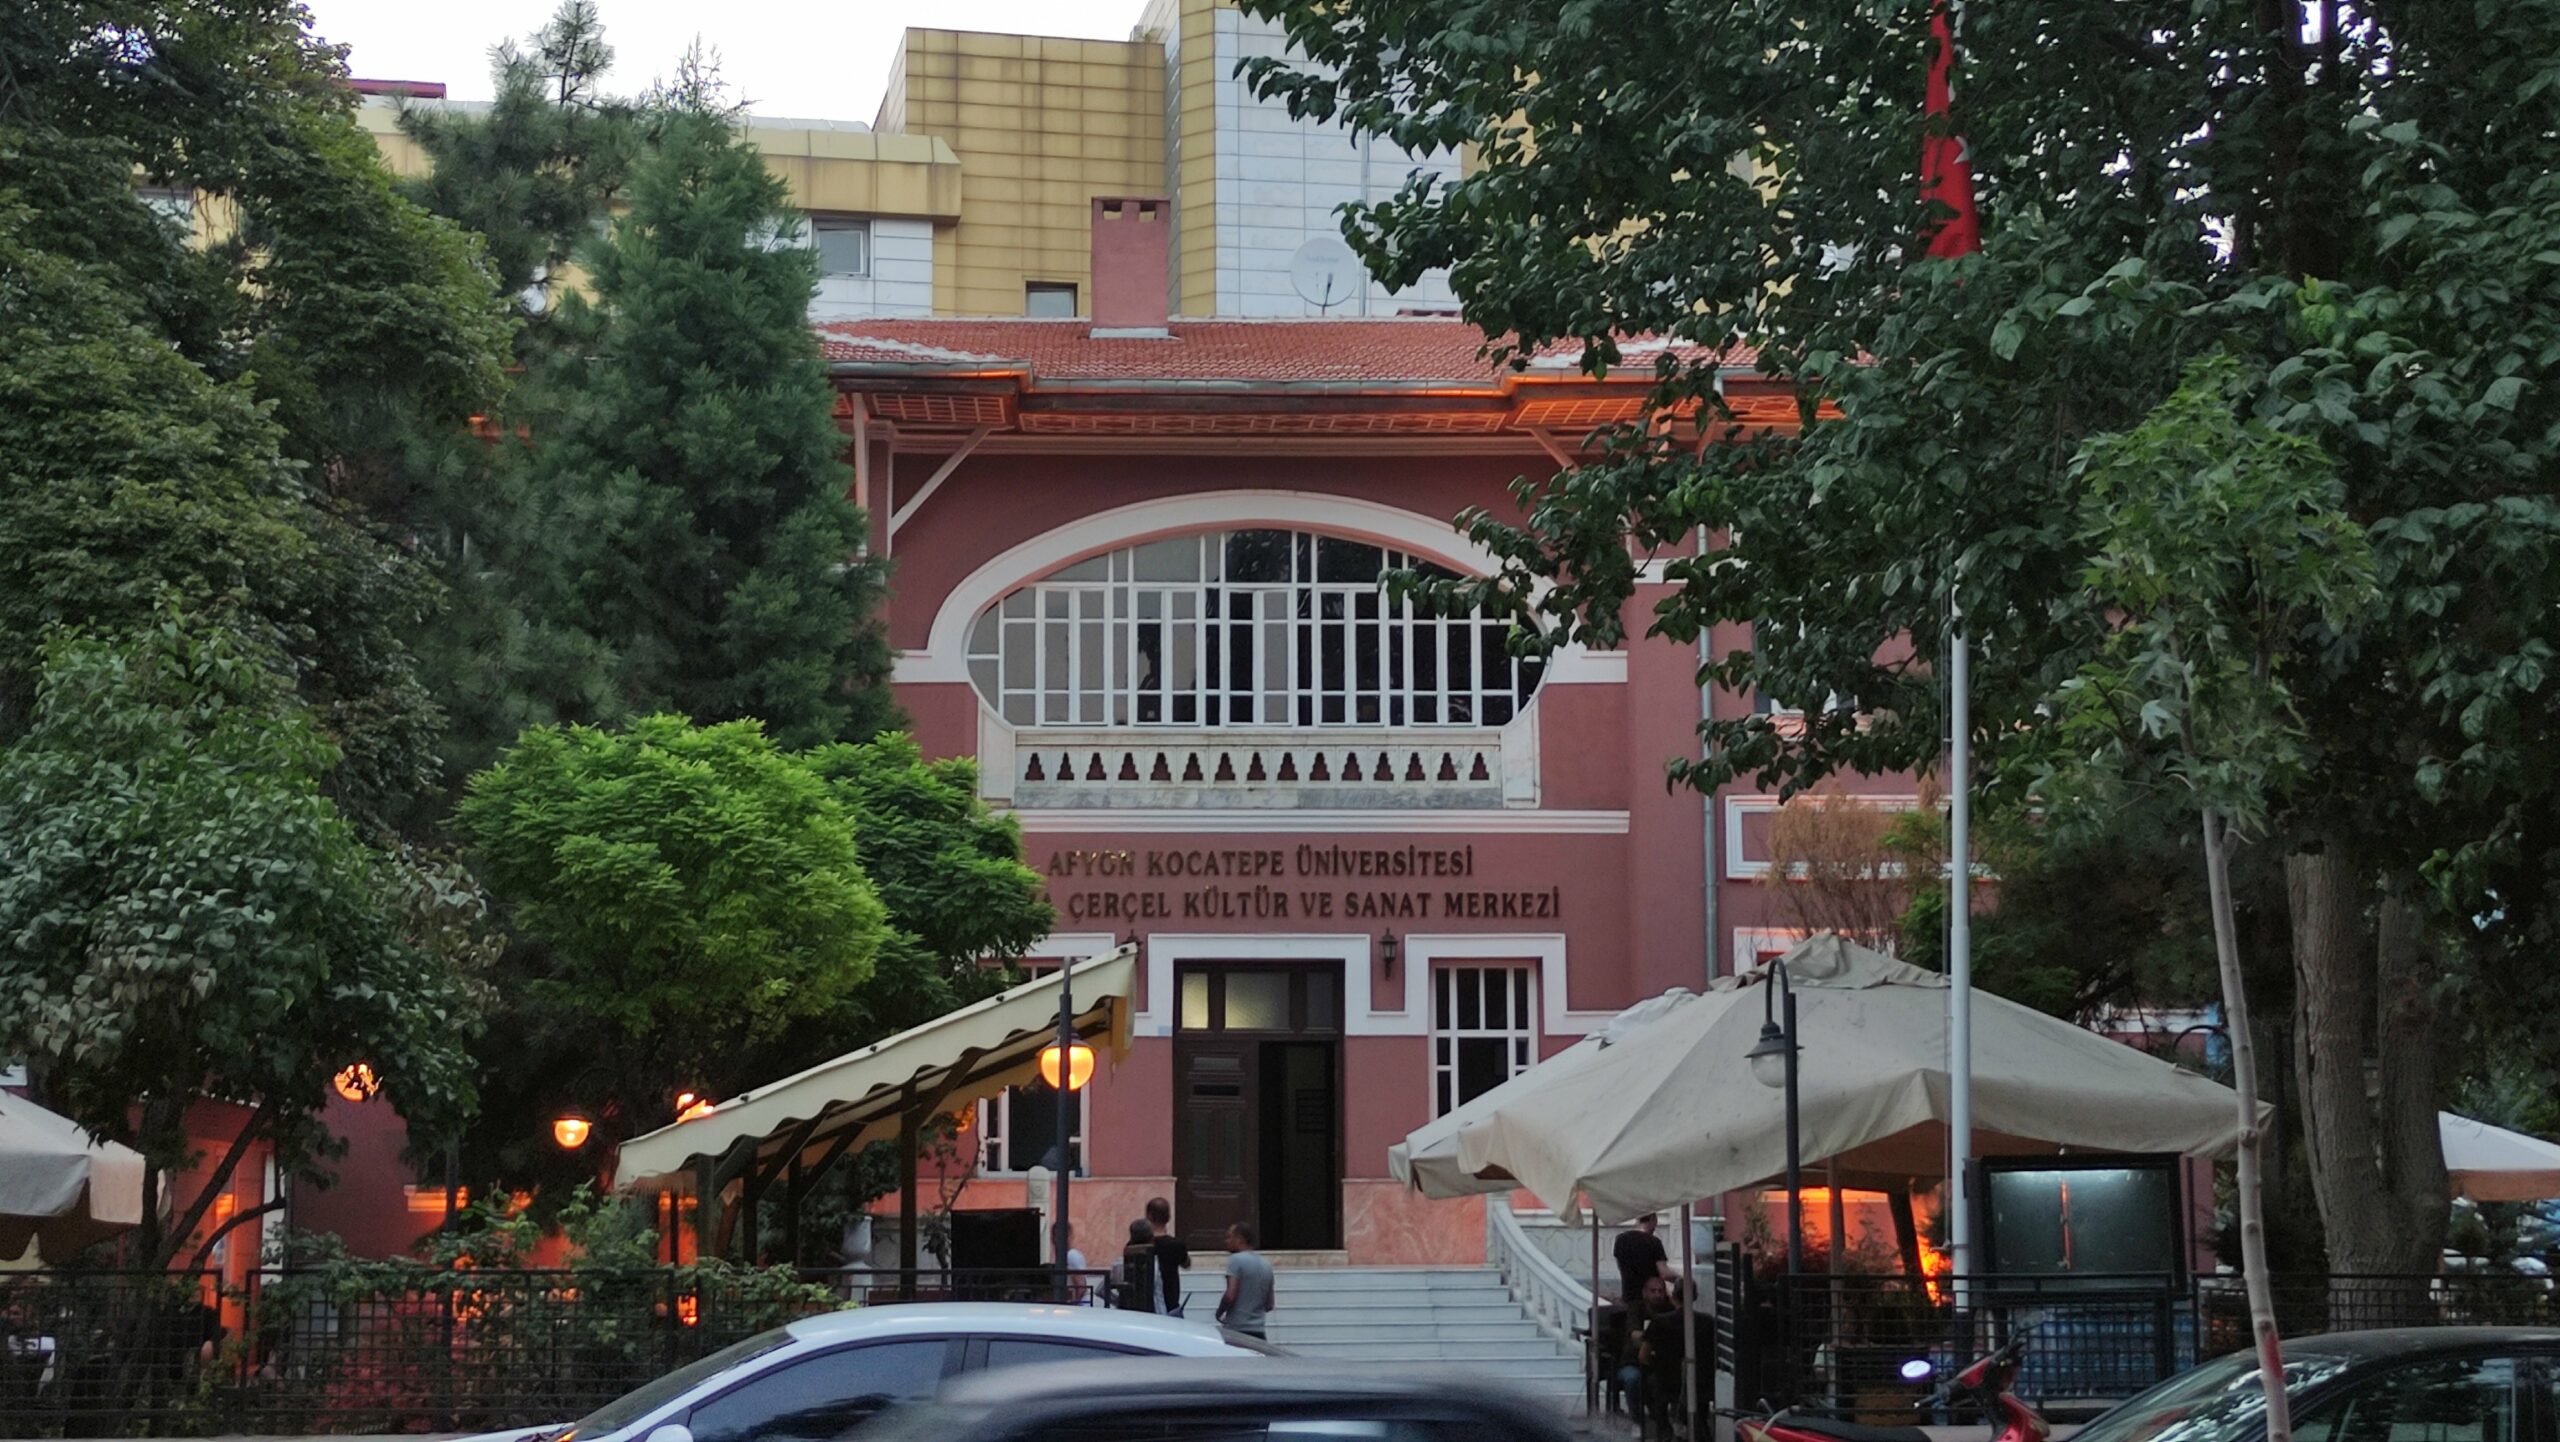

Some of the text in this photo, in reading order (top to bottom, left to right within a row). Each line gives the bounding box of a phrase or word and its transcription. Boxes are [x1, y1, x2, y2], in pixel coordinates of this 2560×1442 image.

[1047, 844, 1473, 876] AFYON KOCATEPE ÜNİVERSİTESİ
[1068, 892, 1171, 923] ÇERÇEL
[1184, 885, 1289, 918] KÜLTÜR
[1299, 892, 1333, 918] VE
[1344, 892, 1431, 918] SANAT
[1444, 886, 1560, 918] MERKEZİ
